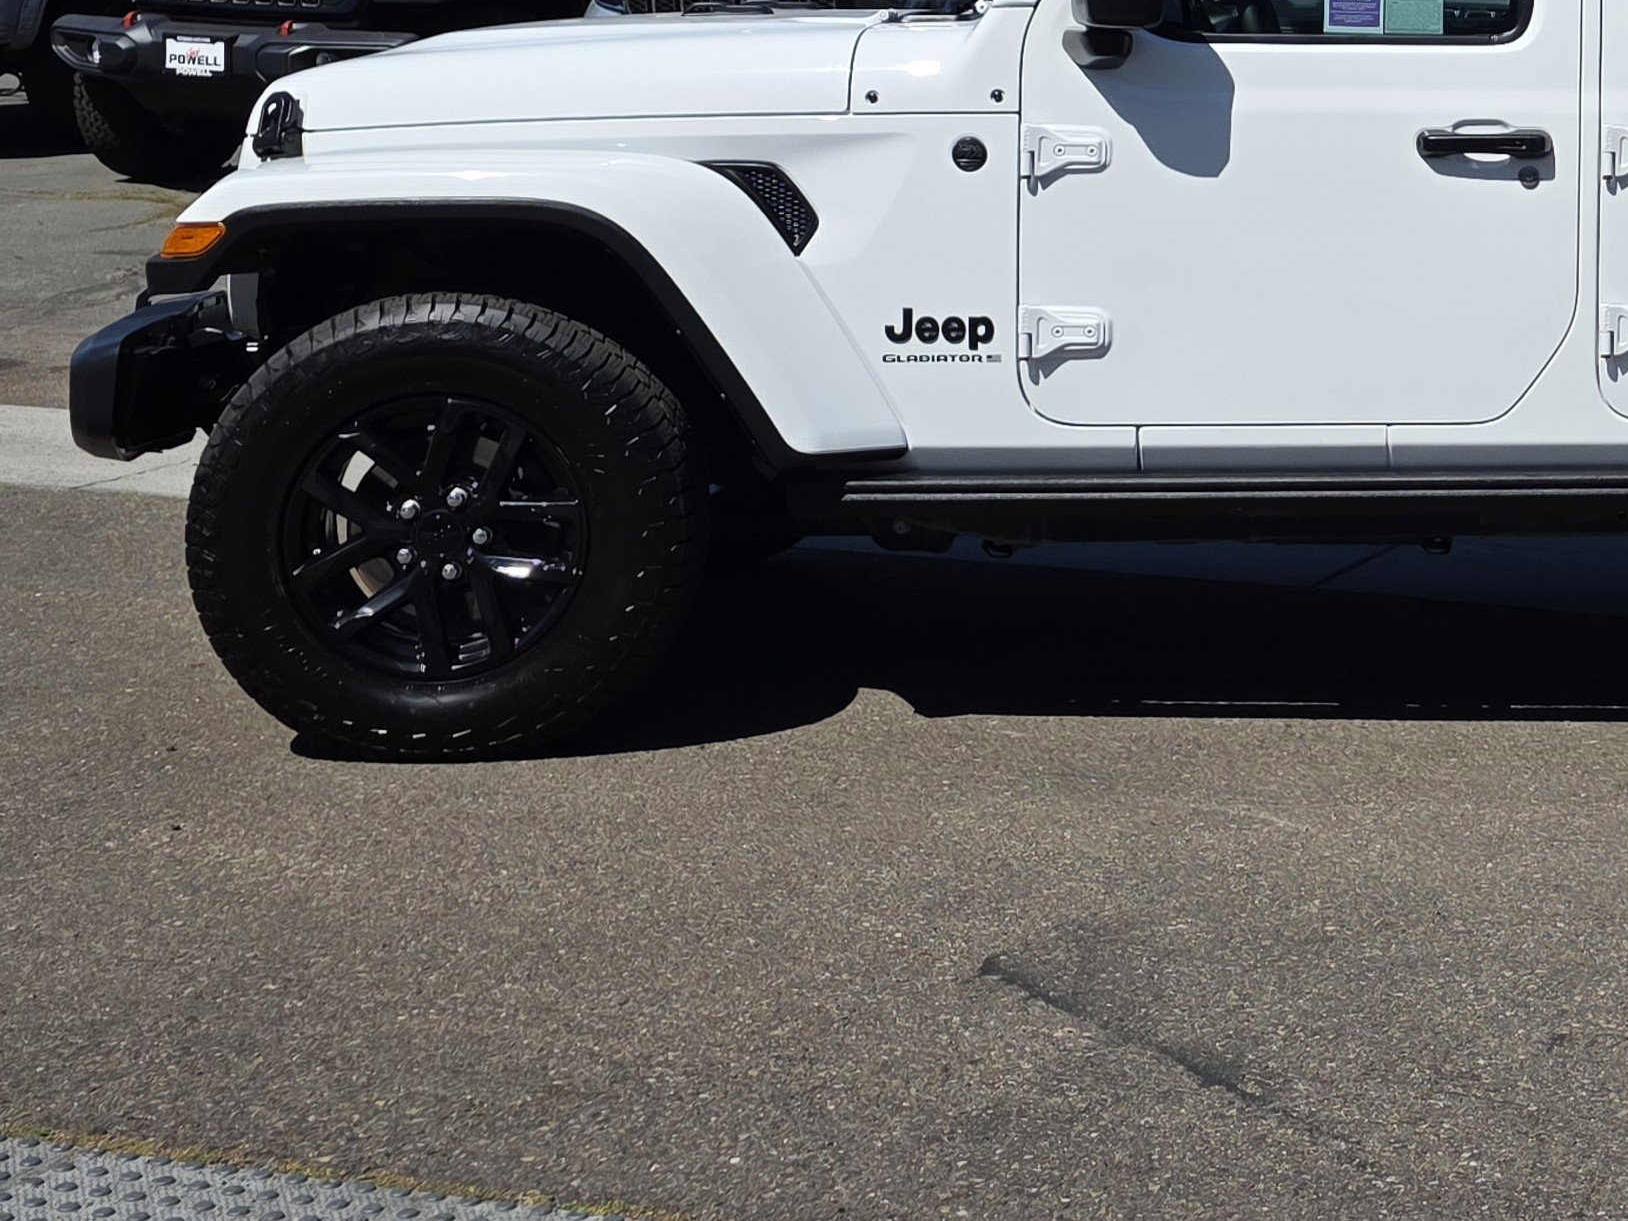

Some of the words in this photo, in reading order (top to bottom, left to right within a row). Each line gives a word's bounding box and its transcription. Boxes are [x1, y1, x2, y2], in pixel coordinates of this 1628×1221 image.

[169, 53, 221, 67] POWELL
[885, 307, 995, 351] Jeep
[882, 353, 983, 363] GLADIATOR
